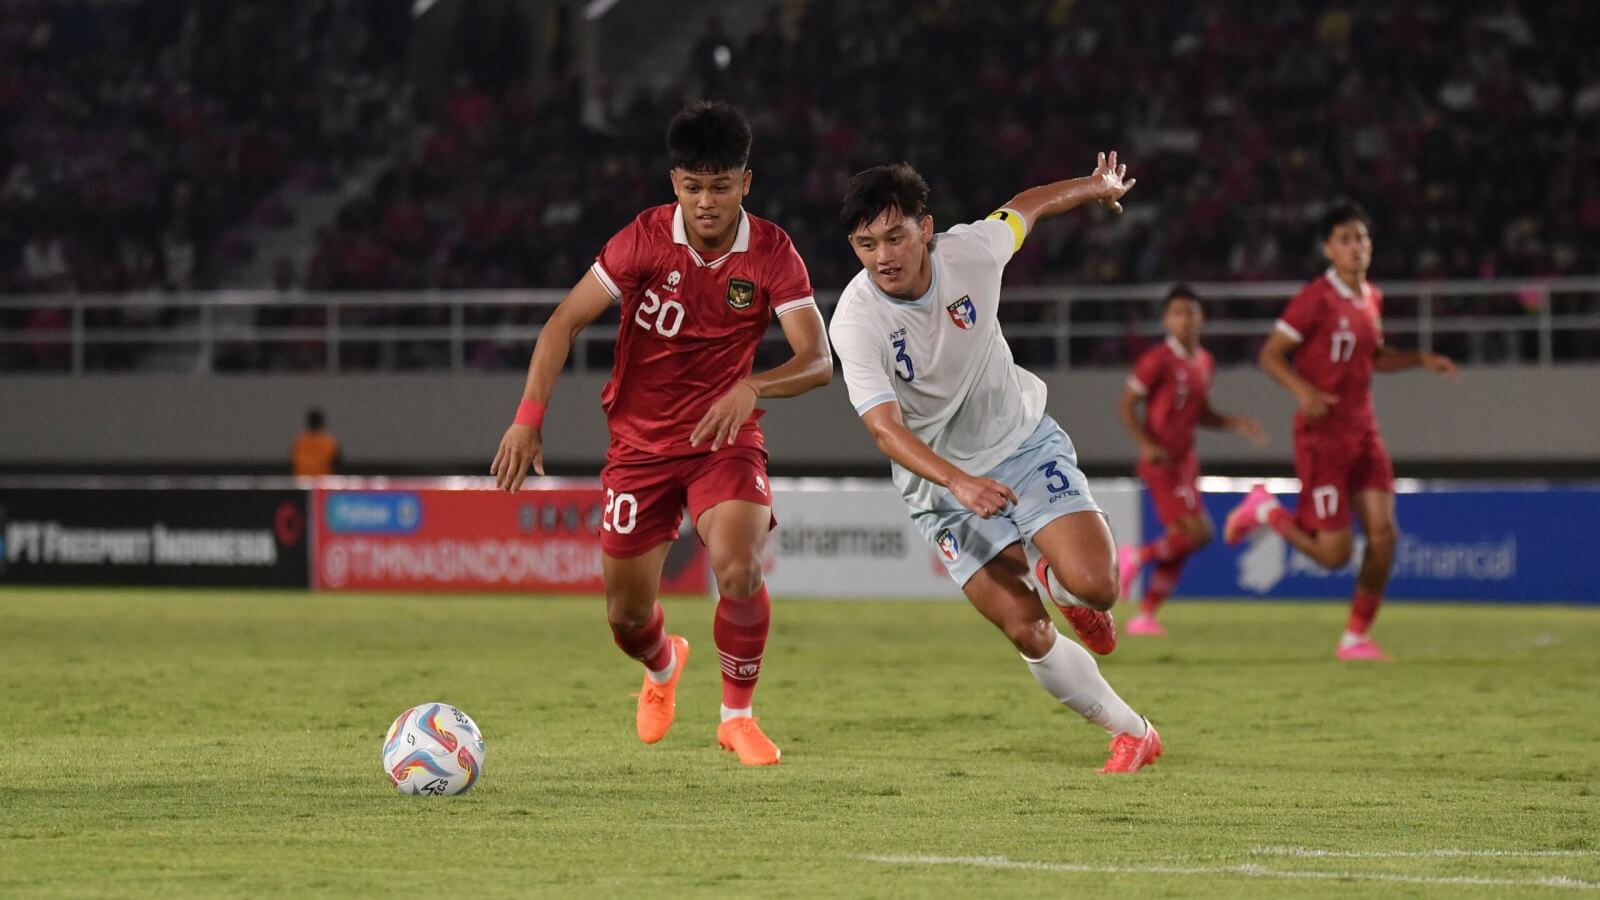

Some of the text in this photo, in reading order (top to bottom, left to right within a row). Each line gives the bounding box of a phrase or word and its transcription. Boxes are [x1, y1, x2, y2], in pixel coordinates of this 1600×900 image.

[635, 289, 685, 337] 20
[893, 338, 914, 382] 3
[1331, 331, 1356, 362] 17
[1037, 460, 1070, 493] 3
[603, 488, 638, 534] 20
[1049, 489, 1081, 504] ENTES
[1313, 485, 1339, 519] 17
[6, 521, 40, 564] PT
